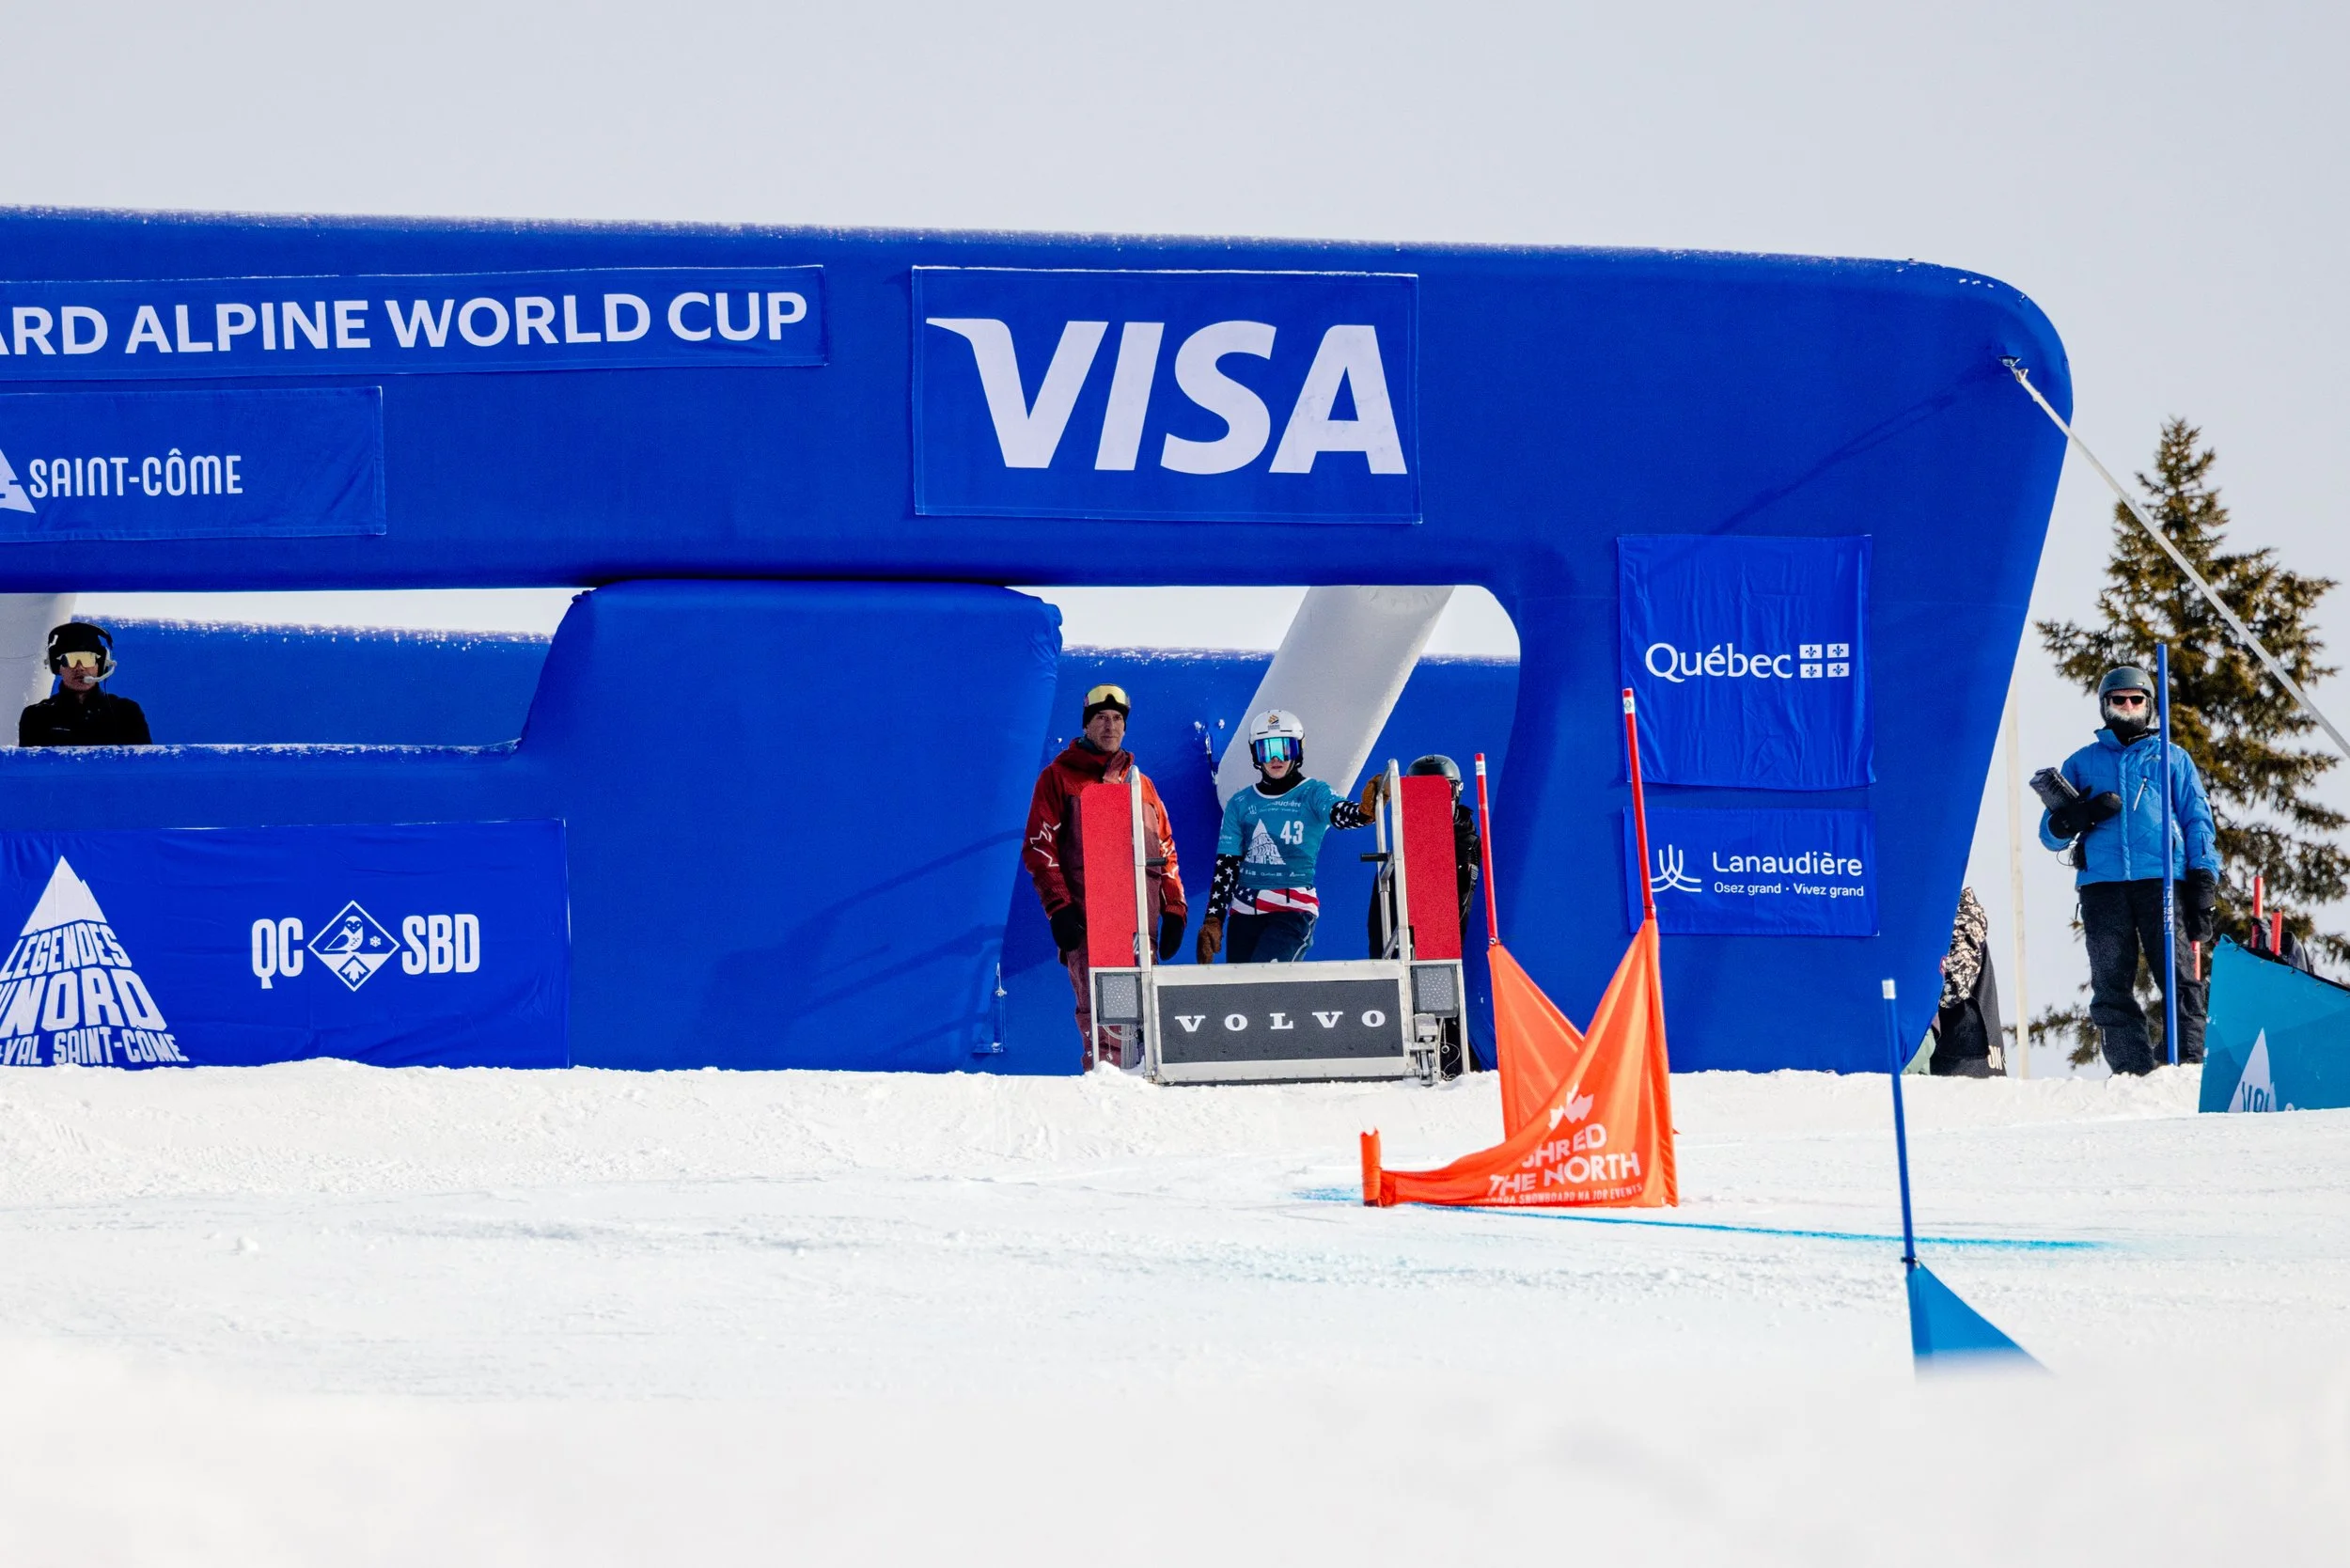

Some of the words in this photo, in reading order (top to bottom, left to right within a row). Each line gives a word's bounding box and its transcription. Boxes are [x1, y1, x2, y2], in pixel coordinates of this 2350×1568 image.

[0, 306, 108, 355] RD
[125, 300, 370, 353] ALPINE
[384, 292, 650, 348] WORLD
[667, 291, 807, 341] CUP
[926, 317, 1408, 475] VISA
[29, 447, 243, 499] SAINT-CÔME
[1645, 642, 1794, 683] Québec
[1279, 820, 1305, 845] 43
[1712, 851, 1863, 877] Lanaudière
[1714, 881, 1744, 894] Osez
[1747, 883, 1782, 895] grand
[1792, 883, 1826, 896] Vivez
[1829, 886, 1864, 898] grand
[251, 917, 304, 990] QC
[401, 914, 480, 975] SBD
[0, 966, 167, 1040] NORD
[1175, 1010, 1386, 1032] VOLVO
[3, 1035, 42, 1065] VAL
[53, 1025, 190, 1064] SAINT-CÔME
[1487, 1172, 1536, 1198] THE
[1543, 1152, 1641, 1186] NORTH
[1518, 1189, 1575, 1204] SNOWBOARD
[1609, 1182, 1643, 1200] EVENTS
